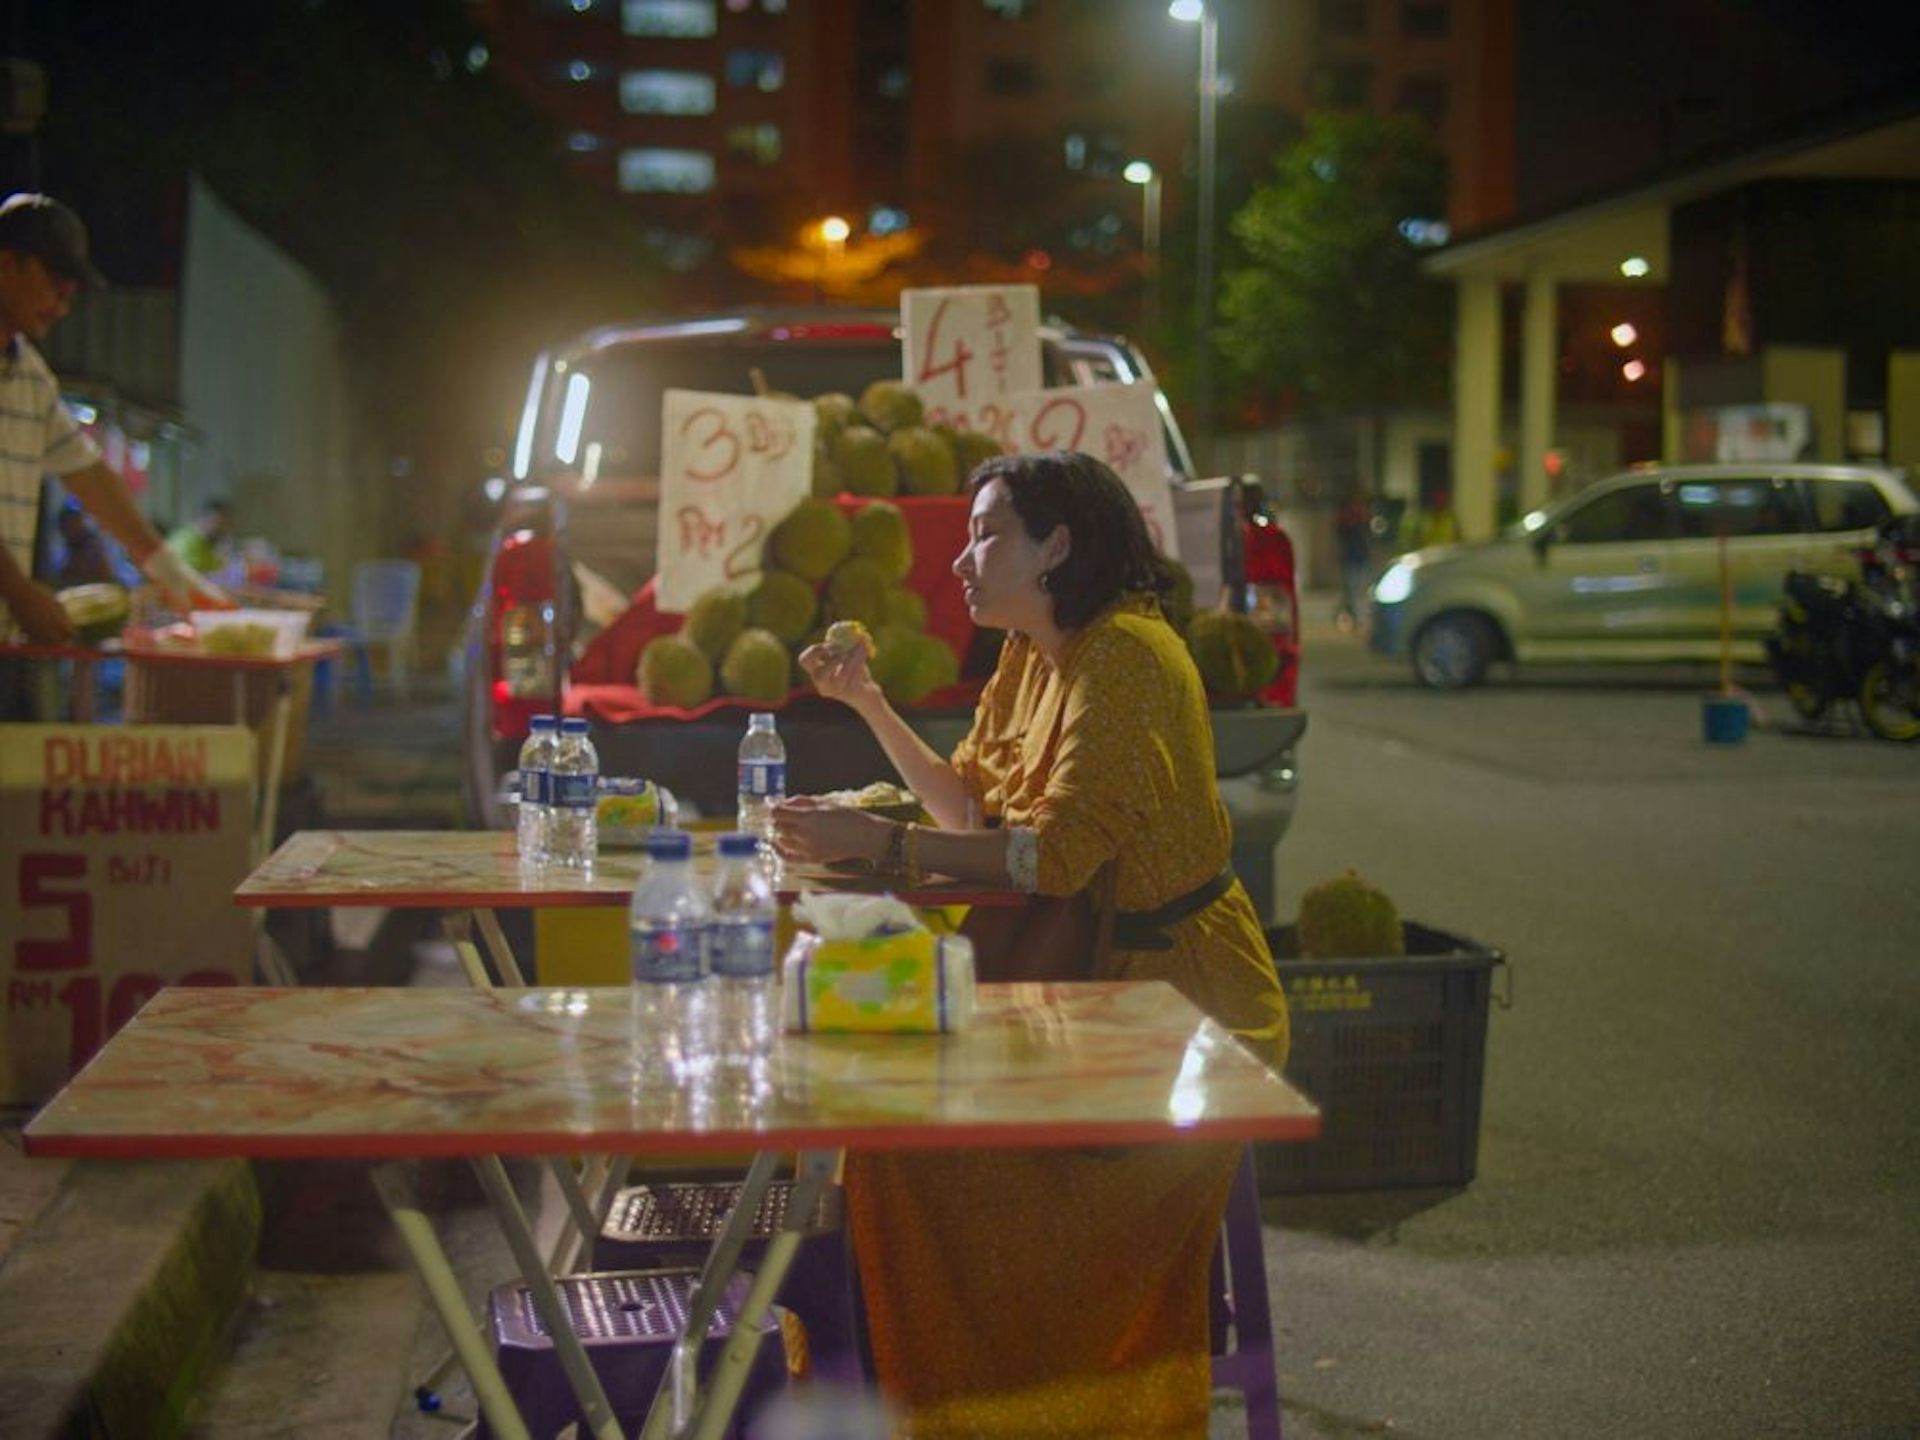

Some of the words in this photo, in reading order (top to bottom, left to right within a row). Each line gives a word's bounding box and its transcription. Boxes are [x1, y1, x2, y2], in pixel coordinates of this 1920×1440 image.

[918, 299, 973, 400] 4
[680, 407, 741, 482] 3
[44, 736, 207, 783] DURIAN
[40, 788, 220, 837] KAHWIN
[16, 852, 94, 971] 5
[9, 977, 53, 1010] RM
